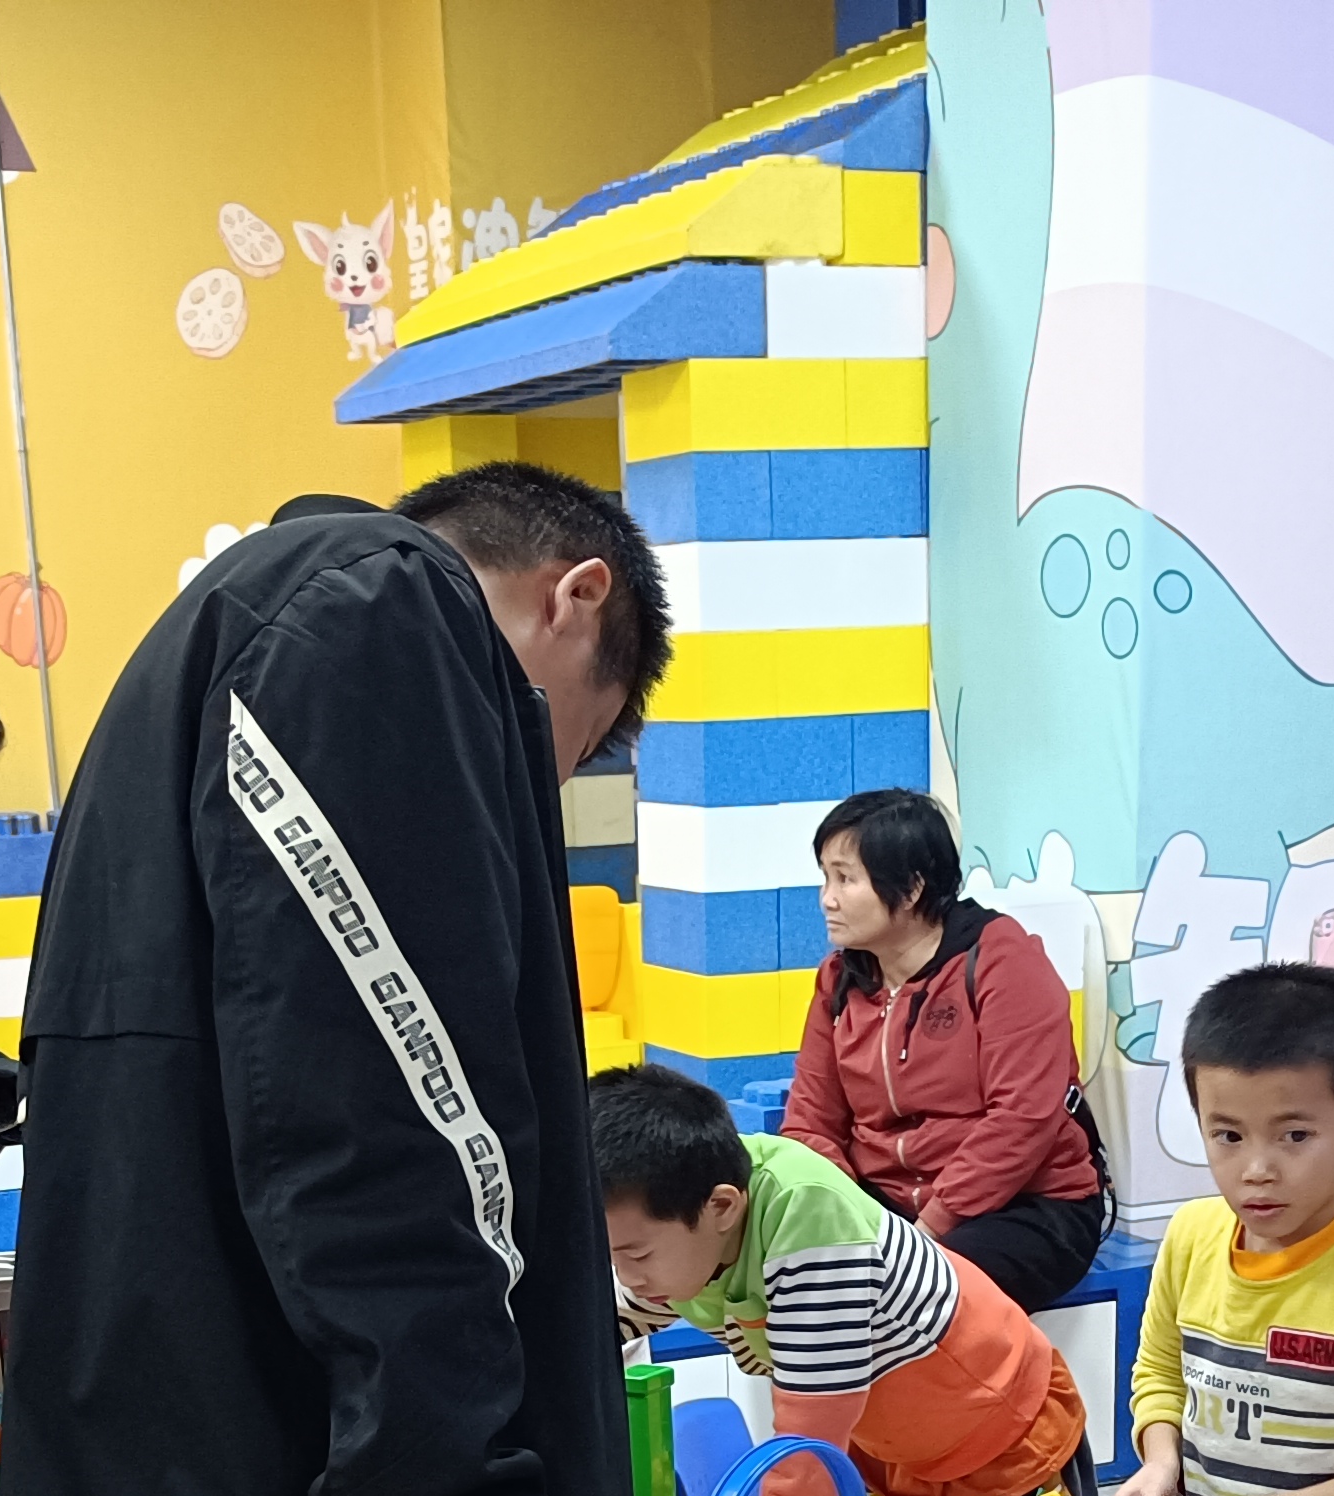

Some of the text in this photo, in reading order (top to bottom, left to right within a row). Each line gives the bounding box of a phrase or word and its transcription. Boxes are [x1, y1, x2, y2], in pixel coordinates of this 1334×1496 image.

[273, 814, 380, 958] GANPOO
[369, 971, 466, 1124] GANPOO
[1182, 1362, 1205, 1383] port
[1235, 1382, 1270, 1399] wen
